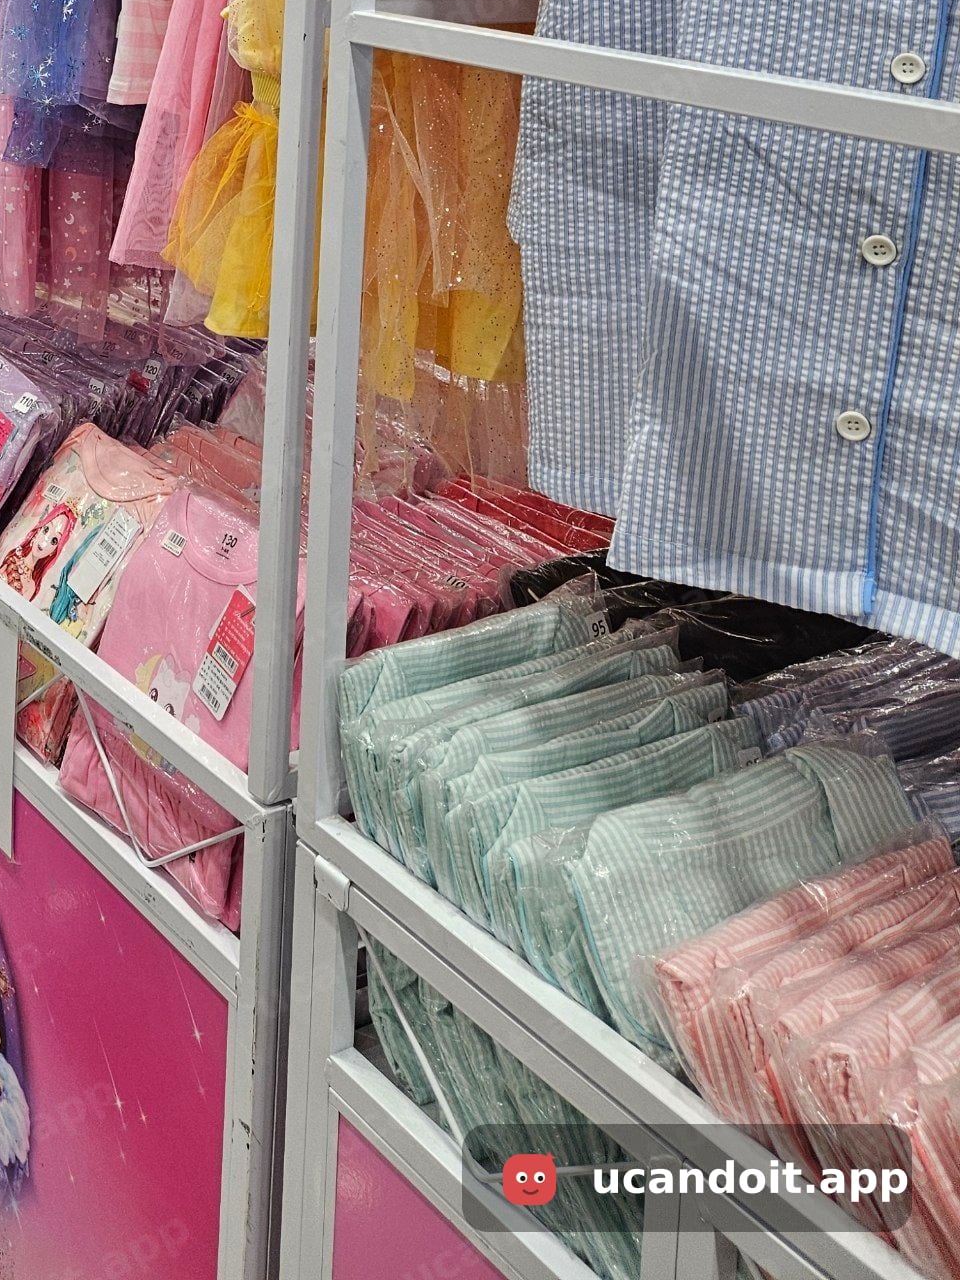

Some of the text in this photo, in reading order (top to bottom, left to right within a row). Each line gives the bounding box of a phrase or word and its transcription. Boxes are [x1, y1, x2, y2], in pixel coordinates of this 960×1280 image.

[145, 365, 158, 375] 120
[20, 396, 33, 408] 110
[222, 533, 238, 548] 130
[592, 620, 606, 637] 95
